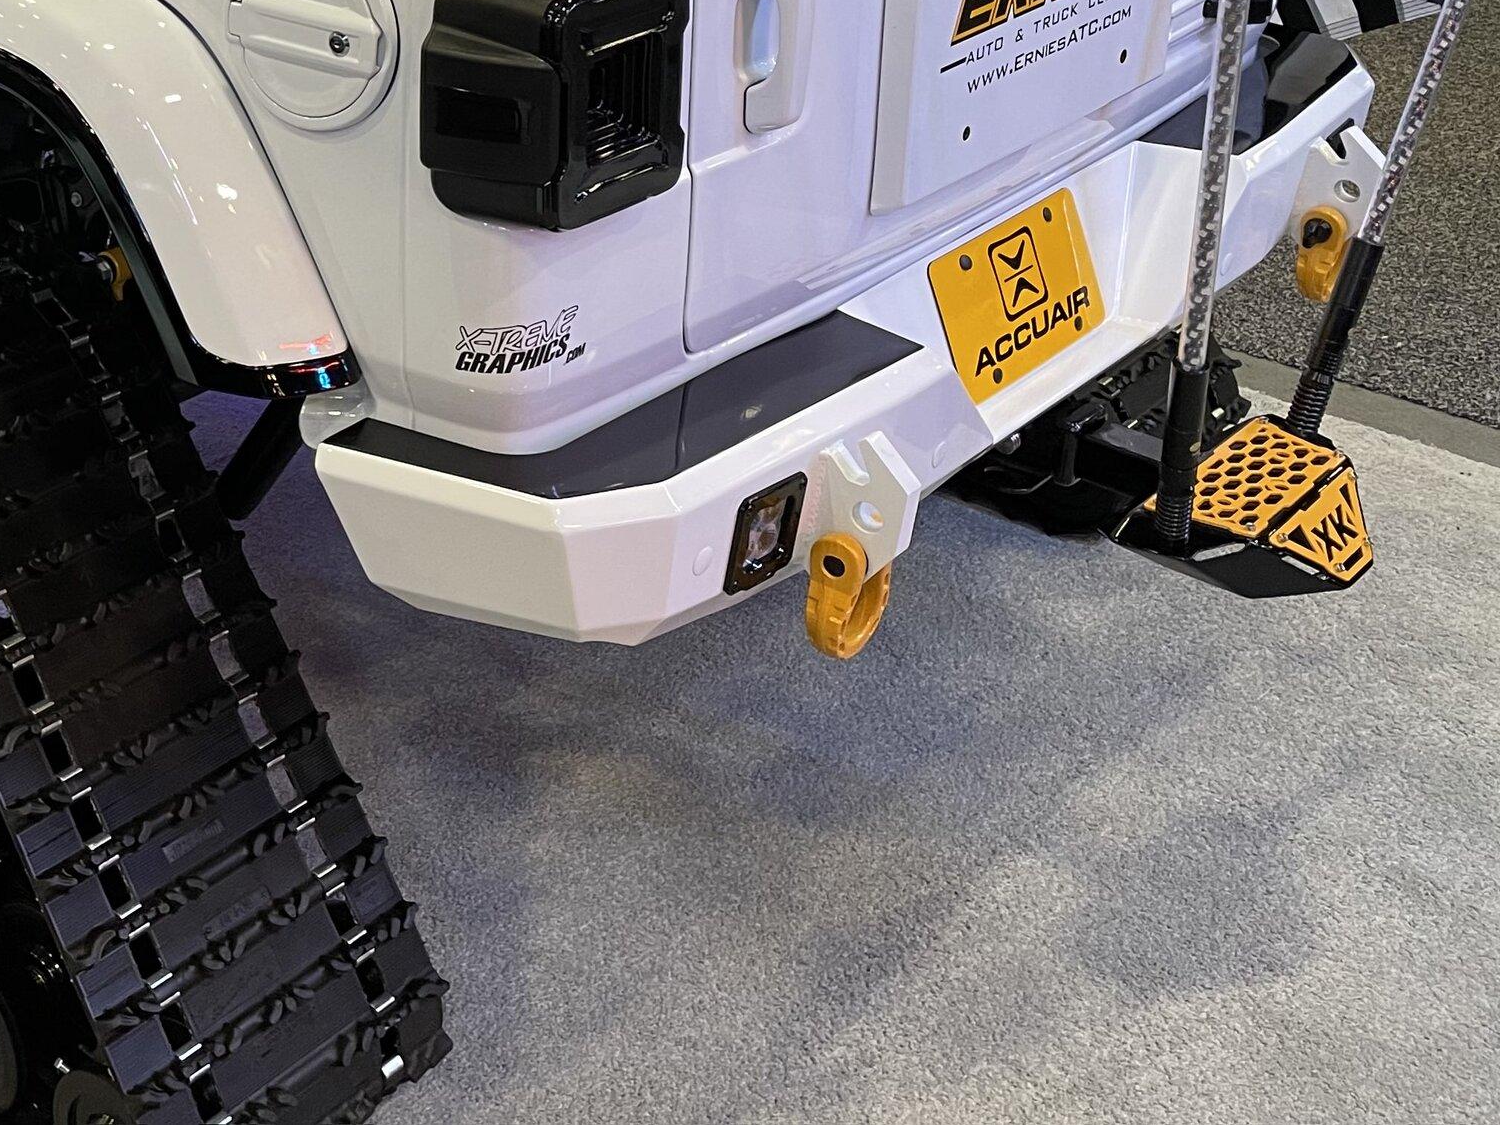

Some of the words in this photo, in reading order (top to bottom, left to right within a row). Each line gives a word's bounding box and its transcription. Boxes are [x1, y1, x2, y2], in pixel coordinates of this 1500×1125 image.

[966, 37, 1004, 65] AUTO
[1015, 28, 1025, 43] &
[1033, 3, 1079, 34] TRUCK
[975, 286, 1091, 378] ACCUAIR
